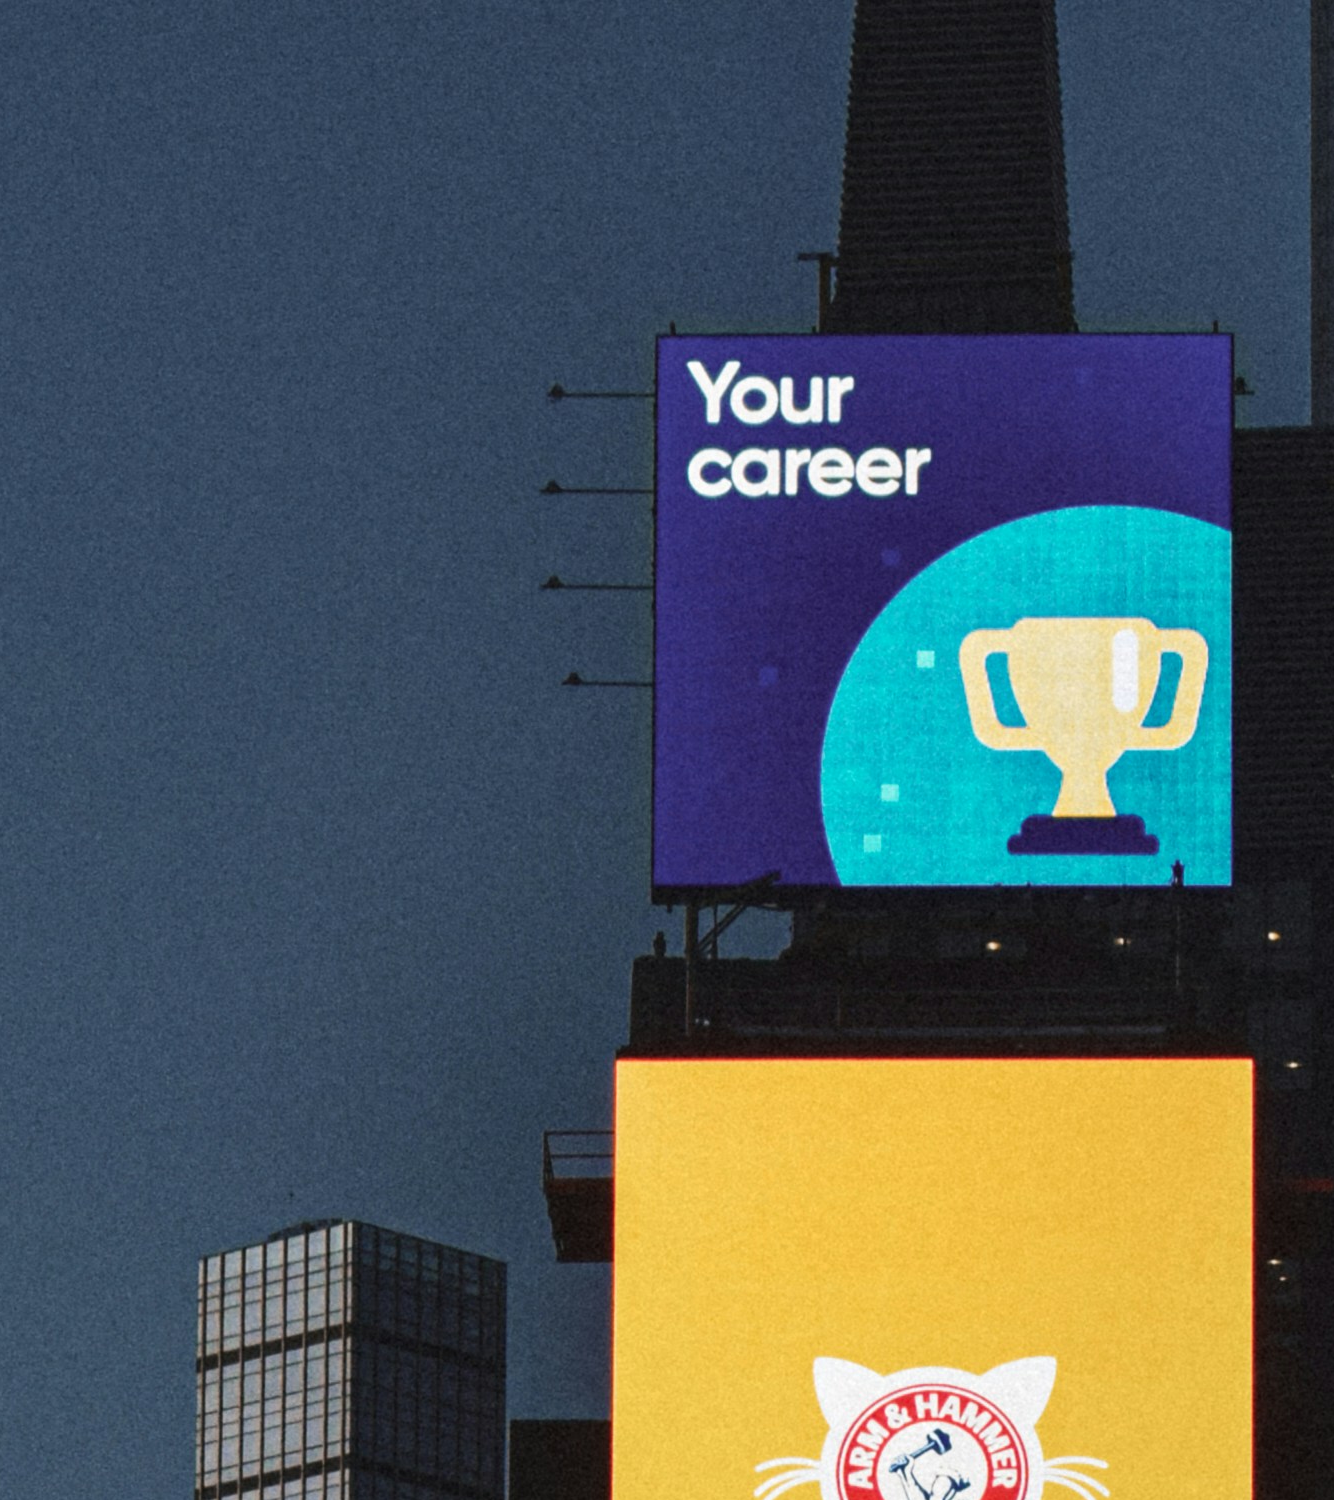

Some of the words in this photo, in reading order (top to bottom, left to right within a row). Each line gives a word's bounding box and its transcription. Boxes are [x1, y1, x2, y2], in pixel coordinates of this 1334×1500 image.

[686, 361, 854, 424] Your
[687, 447, 931, 497] career
[847, 1420, 885, 1489] ARM
[884, 1403, 911, 1430] &
[914, 1392, 1018, 1489] HAMMER
